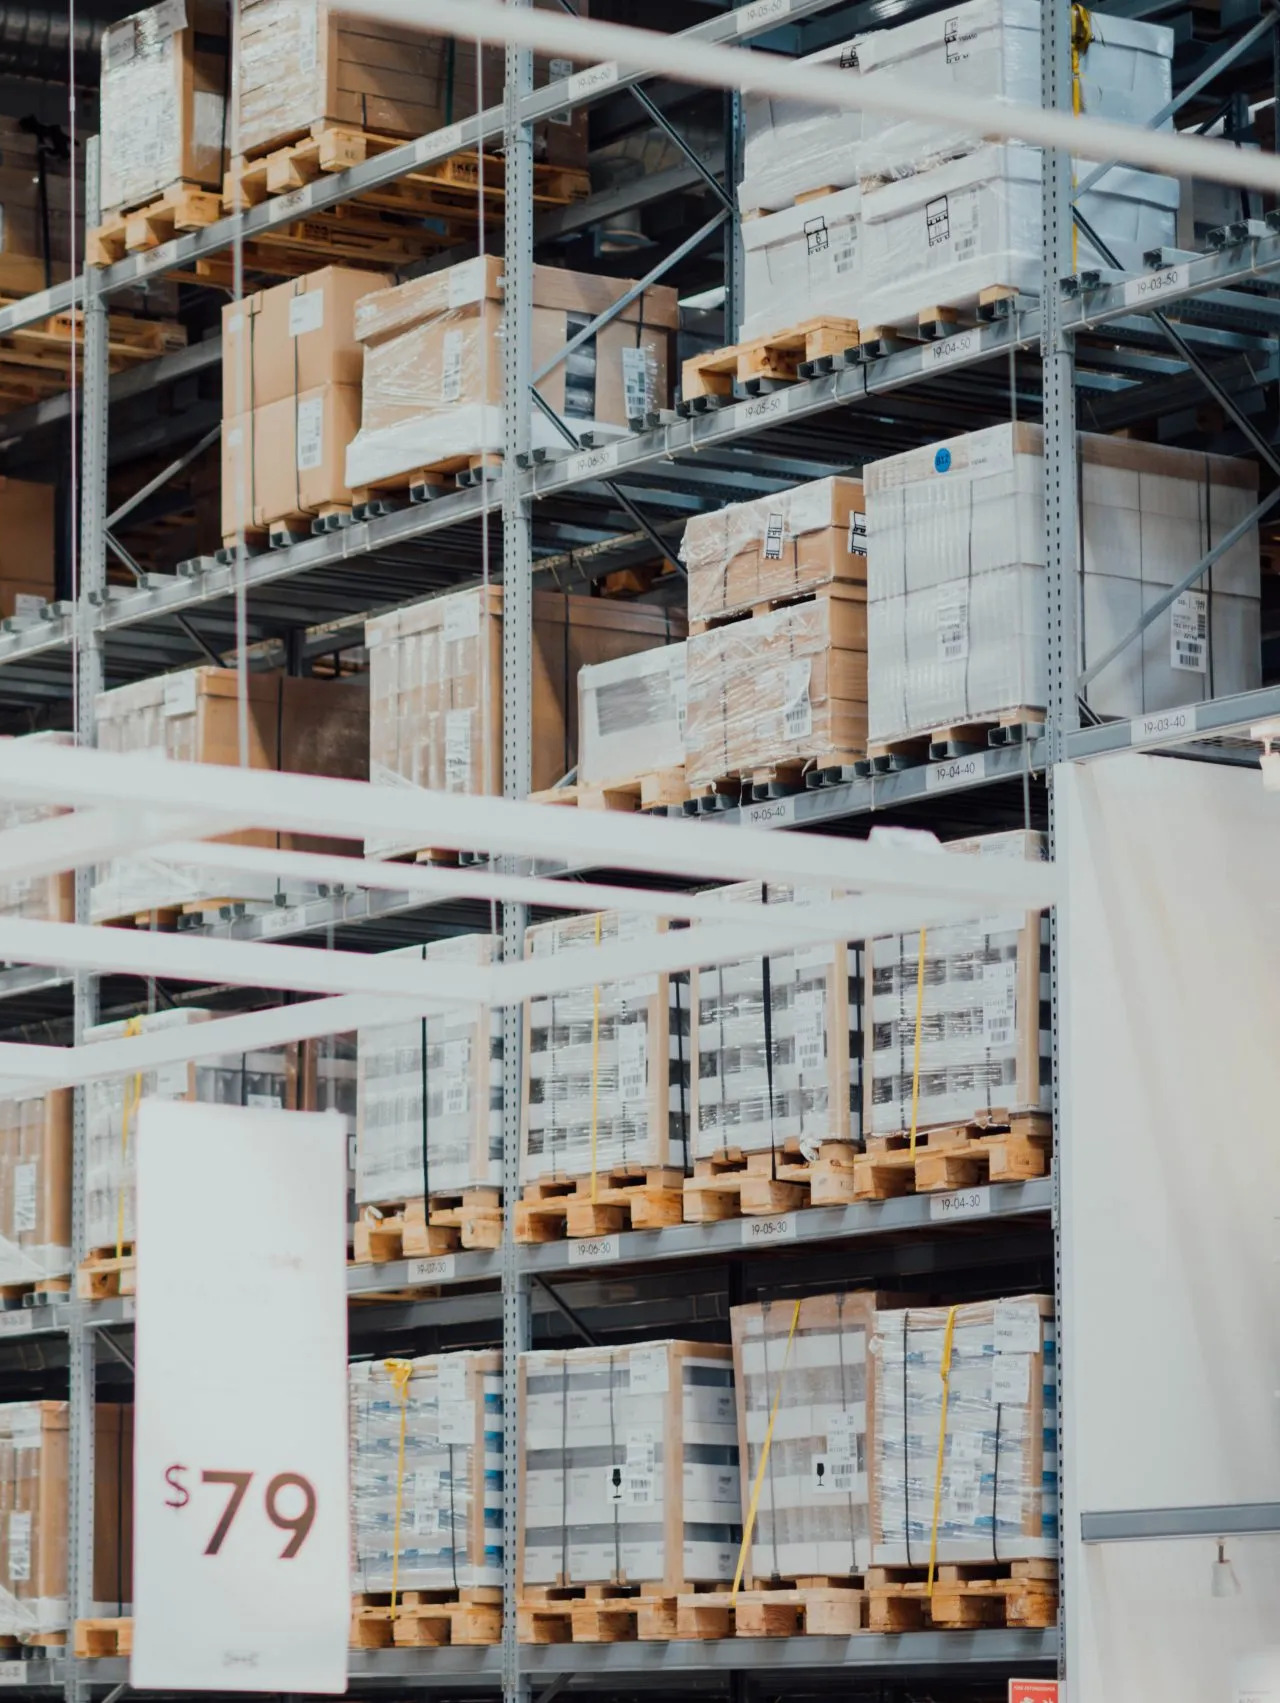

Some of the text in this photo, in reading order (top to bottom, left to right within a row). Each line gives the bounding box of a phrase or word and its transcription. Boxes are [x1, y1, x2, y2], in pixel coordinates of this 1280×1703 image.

[1137, 271, 1177, 296] 19-03-50
[933, 337, 971, 361] 19-04-50
[745, 397, 781, 419] 19-05-50
[1144, 714, 1186, 735] 19-03-40
[936, 762, 976, 781] 19-04-40
[750, 805, 786, 823] 19-05-40
[941, 1194, 981, 1211] 19-04-30
[751, 1220, 787, 1235] 19-05-30
[577, 1243, 611, 1256] 19-06-30
[163, 1462, 319, 1560] $79
